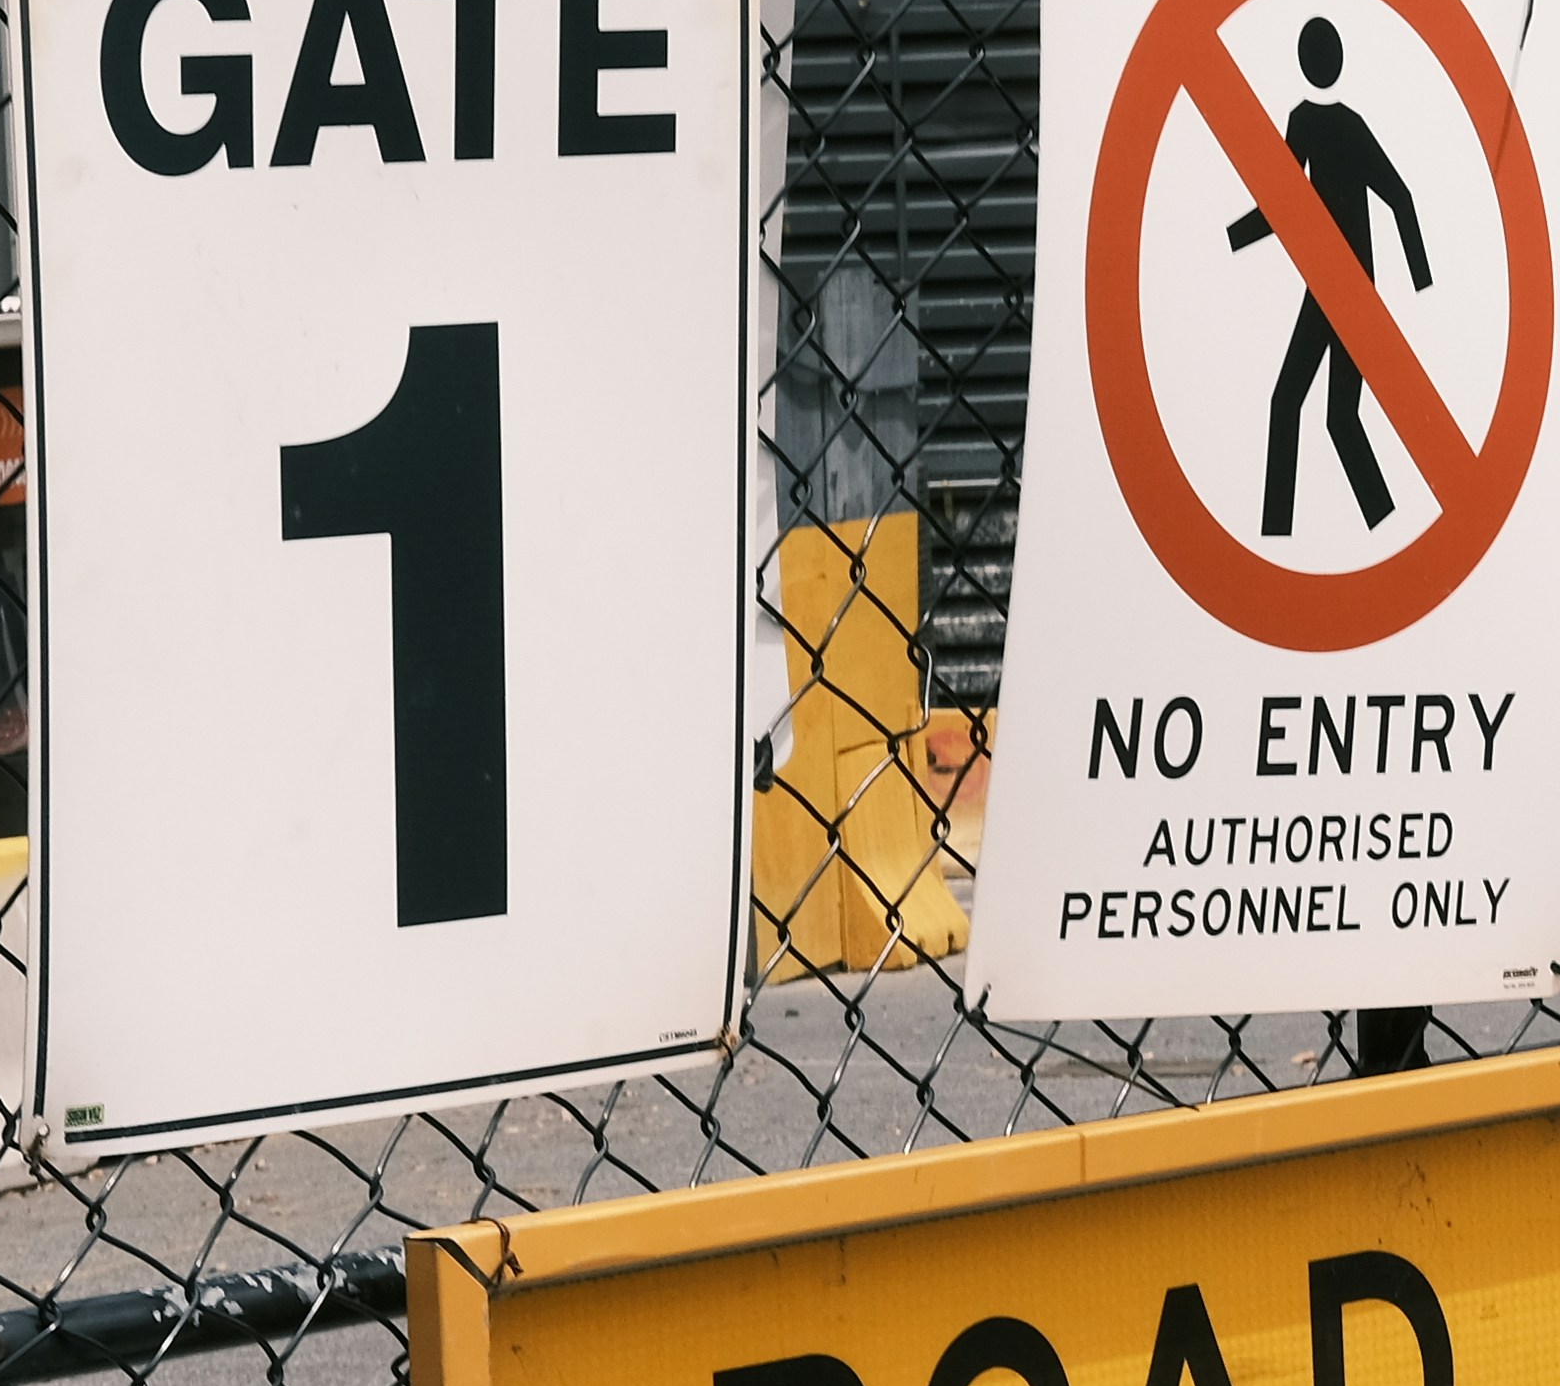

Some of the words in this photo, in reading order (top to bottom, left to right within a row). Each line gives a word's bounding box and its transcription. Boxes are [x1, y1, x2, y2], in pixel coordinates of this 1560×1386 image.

[279, 321, 508, 928] 1
[1087, 696, 1203, 780] NO
[1256, 693, 1516, 777] ENTRY
[1143, 812, 1453, 867] AUTHORISED
[1059, 885, 1361, 940] PERSONNEL
[1391, 877, 1510, 930] ONLY
